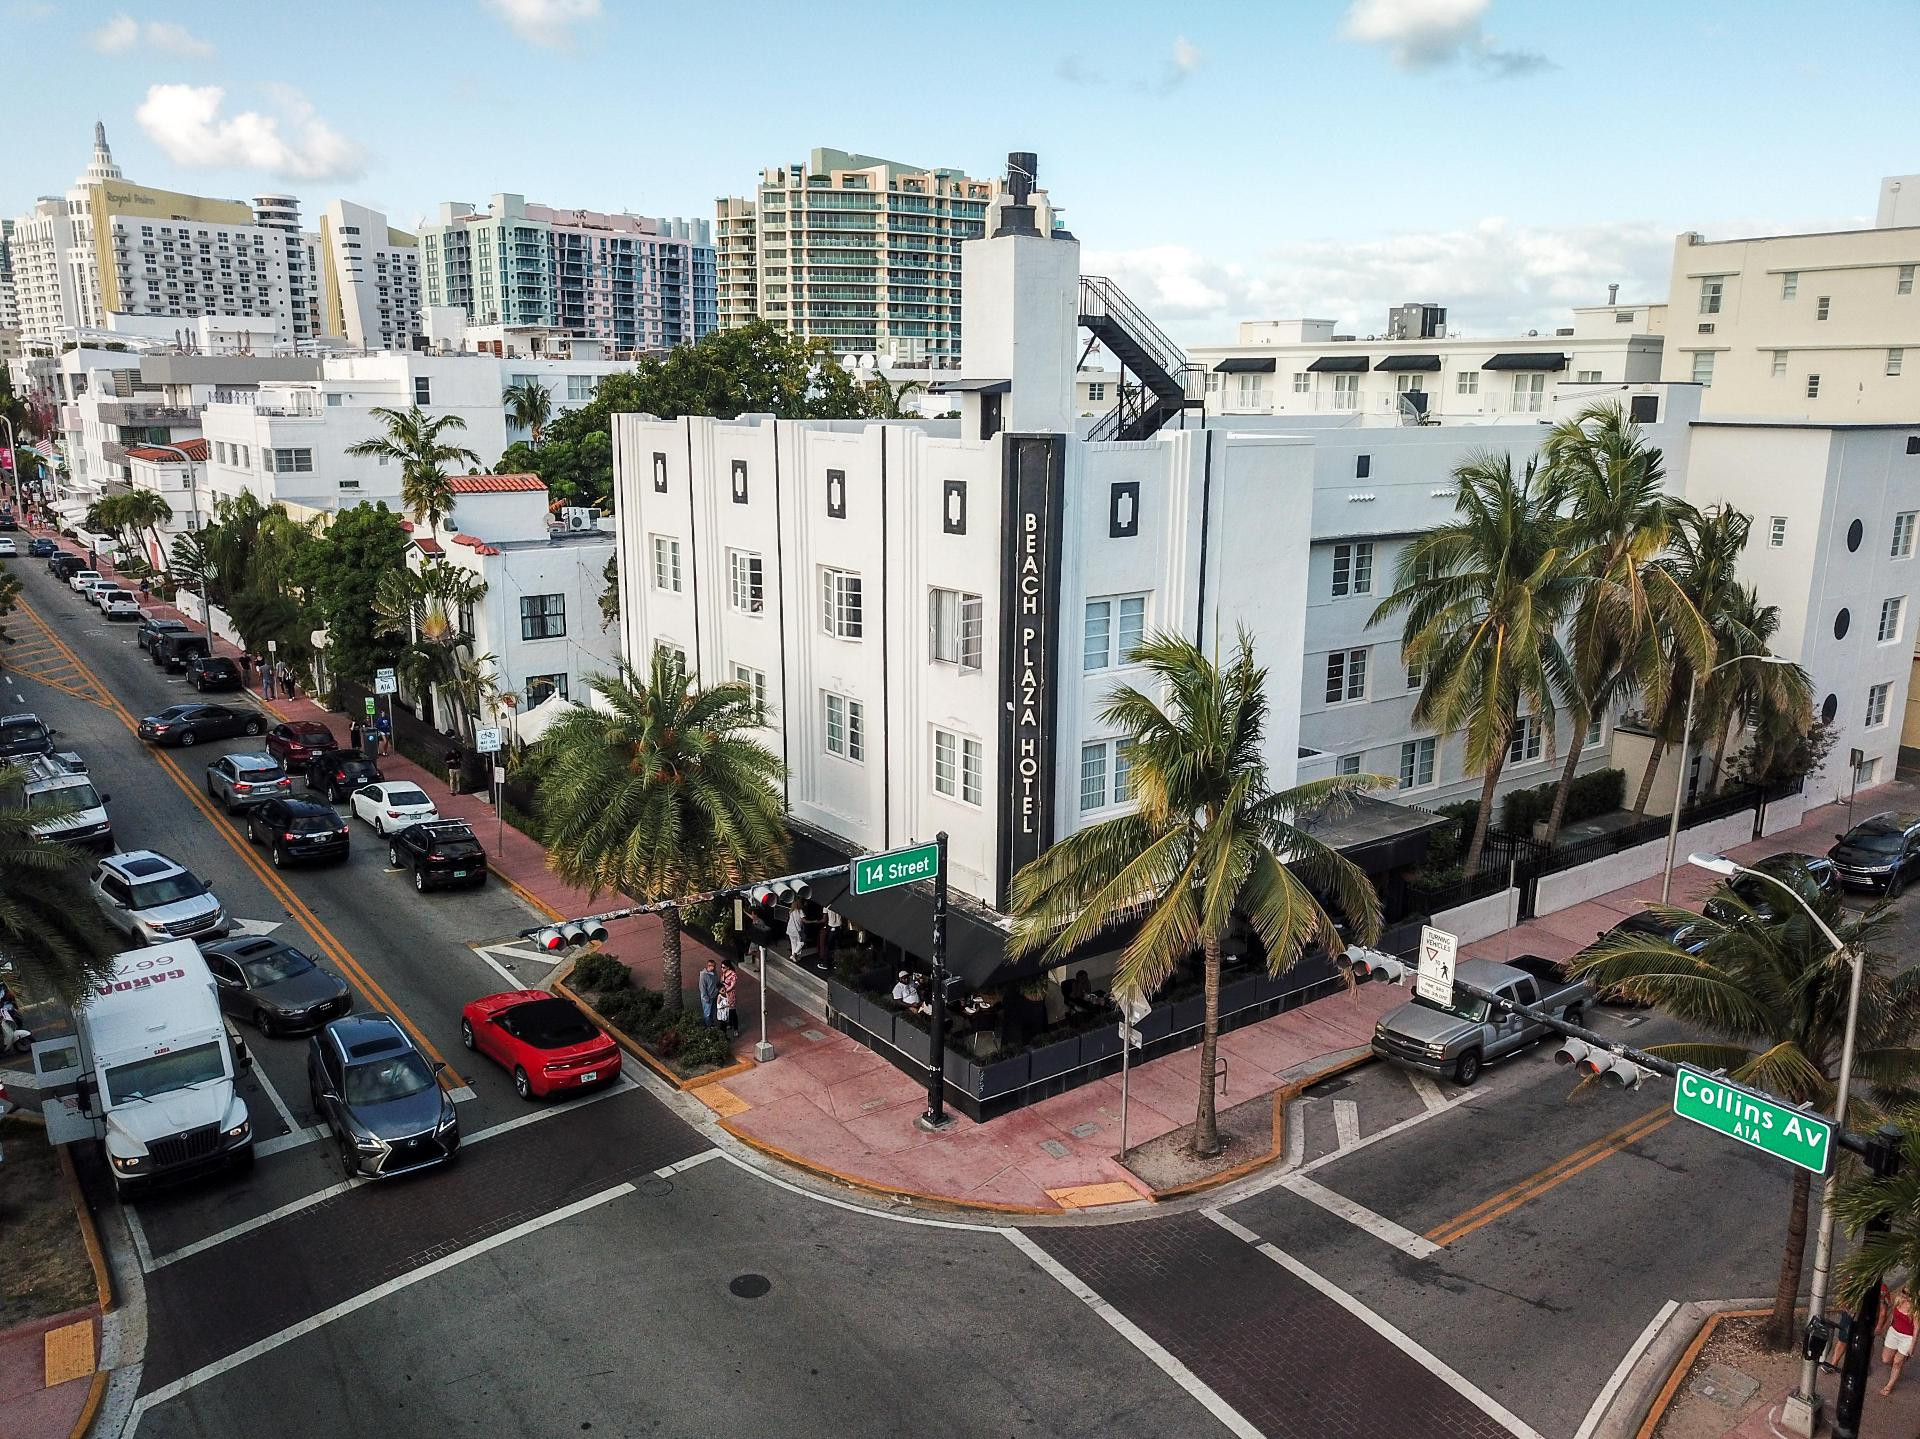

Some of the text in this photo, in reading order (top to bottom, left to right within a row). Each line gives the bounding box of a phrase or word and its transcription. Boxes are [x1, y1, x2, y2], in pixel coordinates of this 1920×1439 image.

[107, 191, 131, 208] Royal
[1019, 513, 1039, 833] BEACH PLAZA HOTEL
[866, 856, 930, 885] 14 Street
[1427, 939, 1451, 953] VEHICLES
[1428, 932, 1451, 945] TURNING
[117, 956, 174, 976] 667
[98, 969, 185, 996] GARDA
[1682, 1075, 1823, 1148] Collins Av
[1733, 1121, 1761, 1144] A1A
